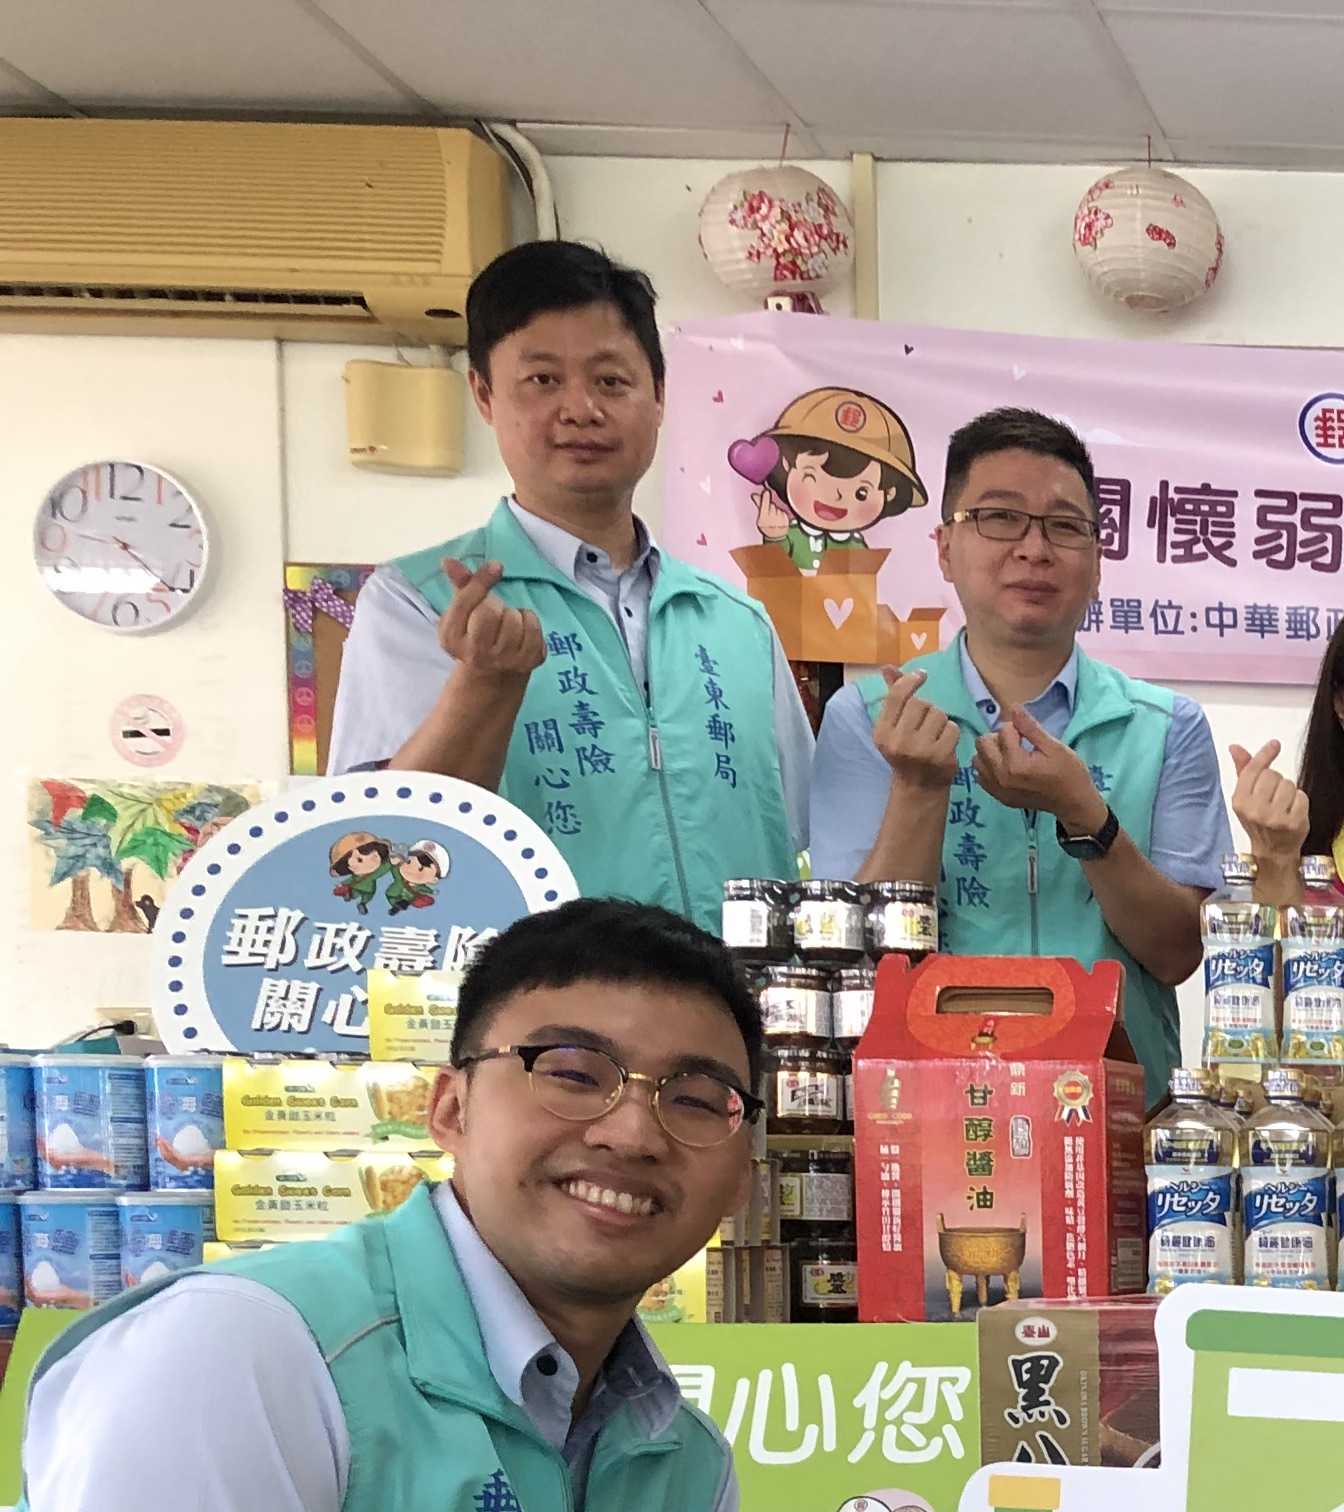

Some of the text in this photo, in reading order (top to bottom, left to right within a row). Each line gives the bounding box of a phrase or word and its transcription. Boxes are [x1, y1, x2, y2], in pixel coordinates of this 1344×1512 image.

[547, 631, 615, 778] 郵政壽險
[694, 643, 737, 790] 臺東郵局
[524, 718, 583, 837] 關心您
[963, 1083, 995, 1211] 甘醇醬油
[1156, 1192, 1222, 1218] リセッタ
[1253, 1192, 1319, 1218] リセッタ
[1021, 1324, 1050, 1339] 泰山
